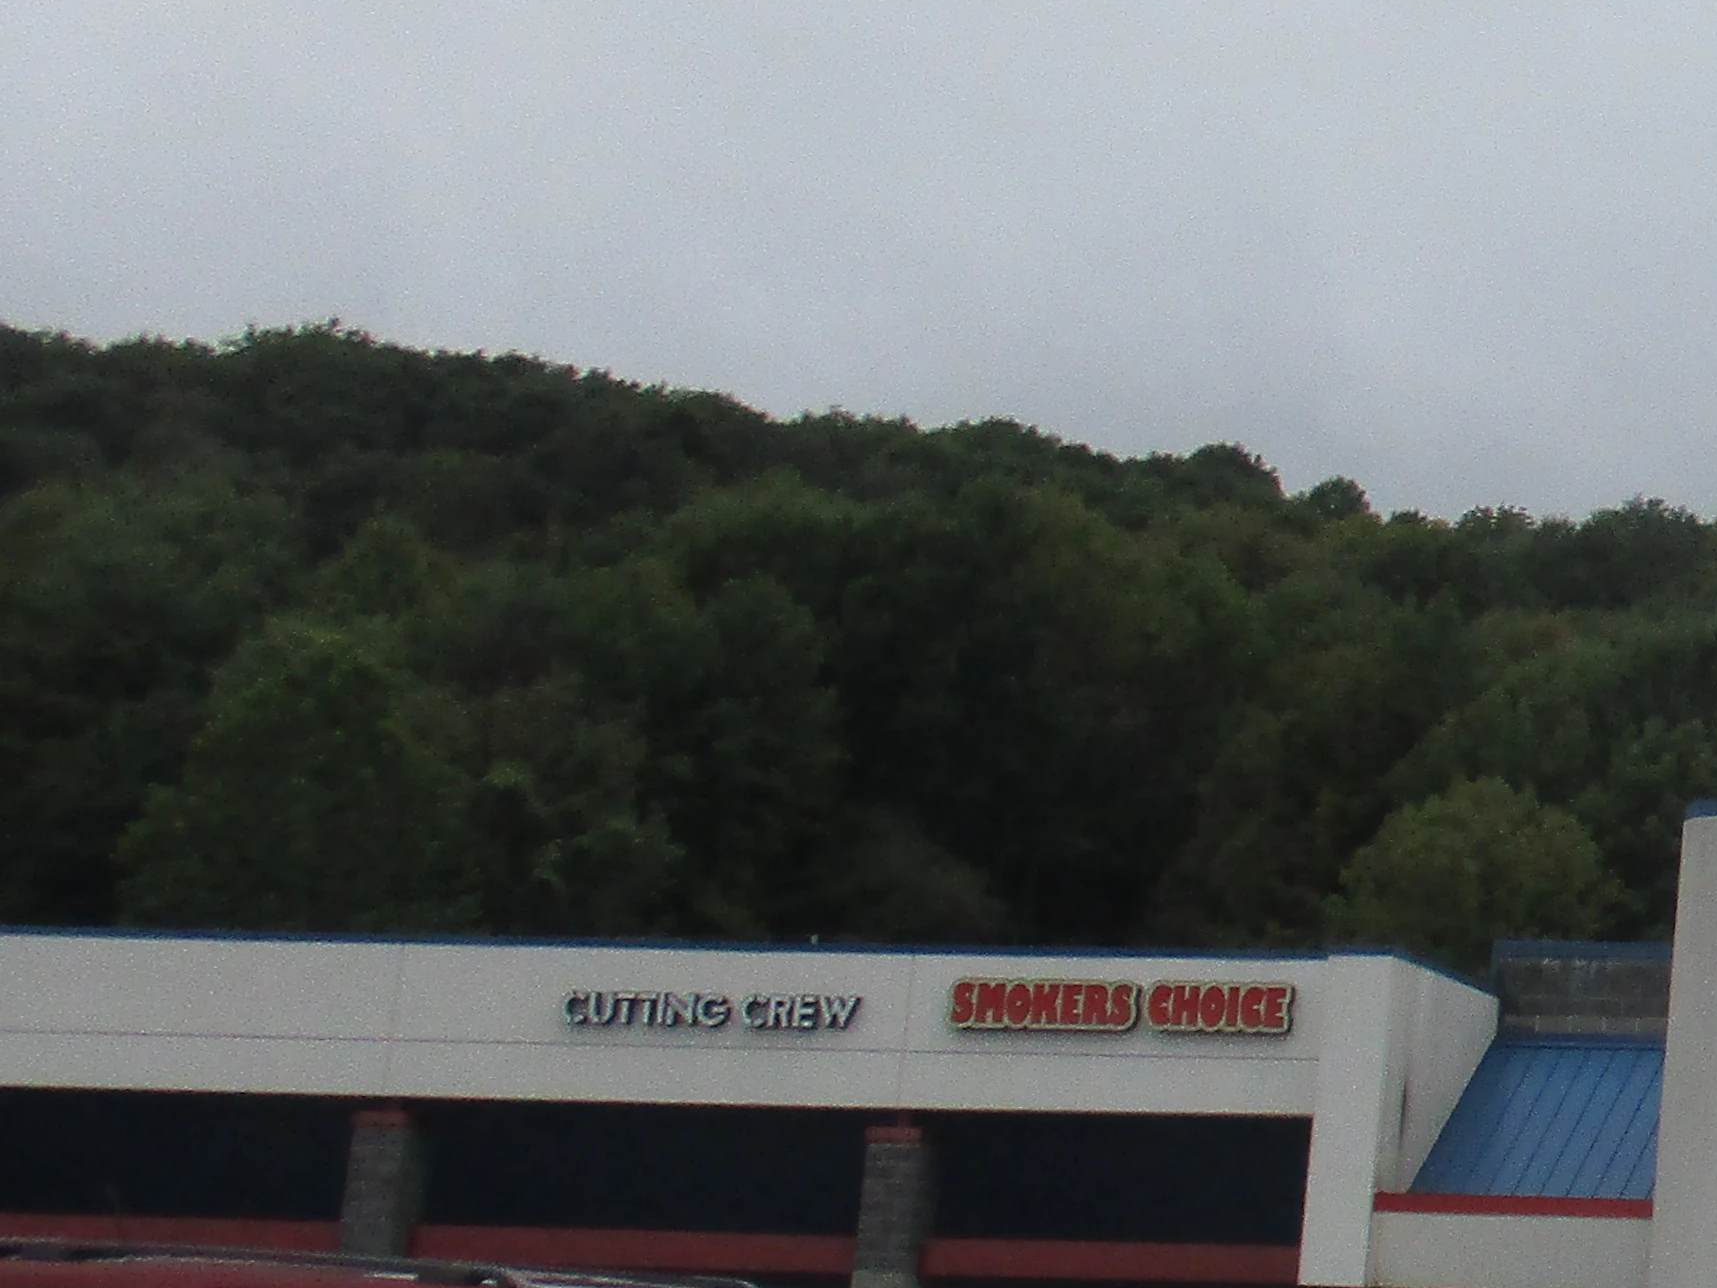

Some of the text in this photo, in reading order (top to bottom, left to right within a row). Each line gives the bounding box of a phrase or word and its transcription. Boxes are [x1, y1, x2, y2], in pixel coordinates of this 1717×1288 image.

[563, 991, 862, 1030] CUTTING CREW
[951, 980, 1289, 1030] SMOKERS CHOICE
